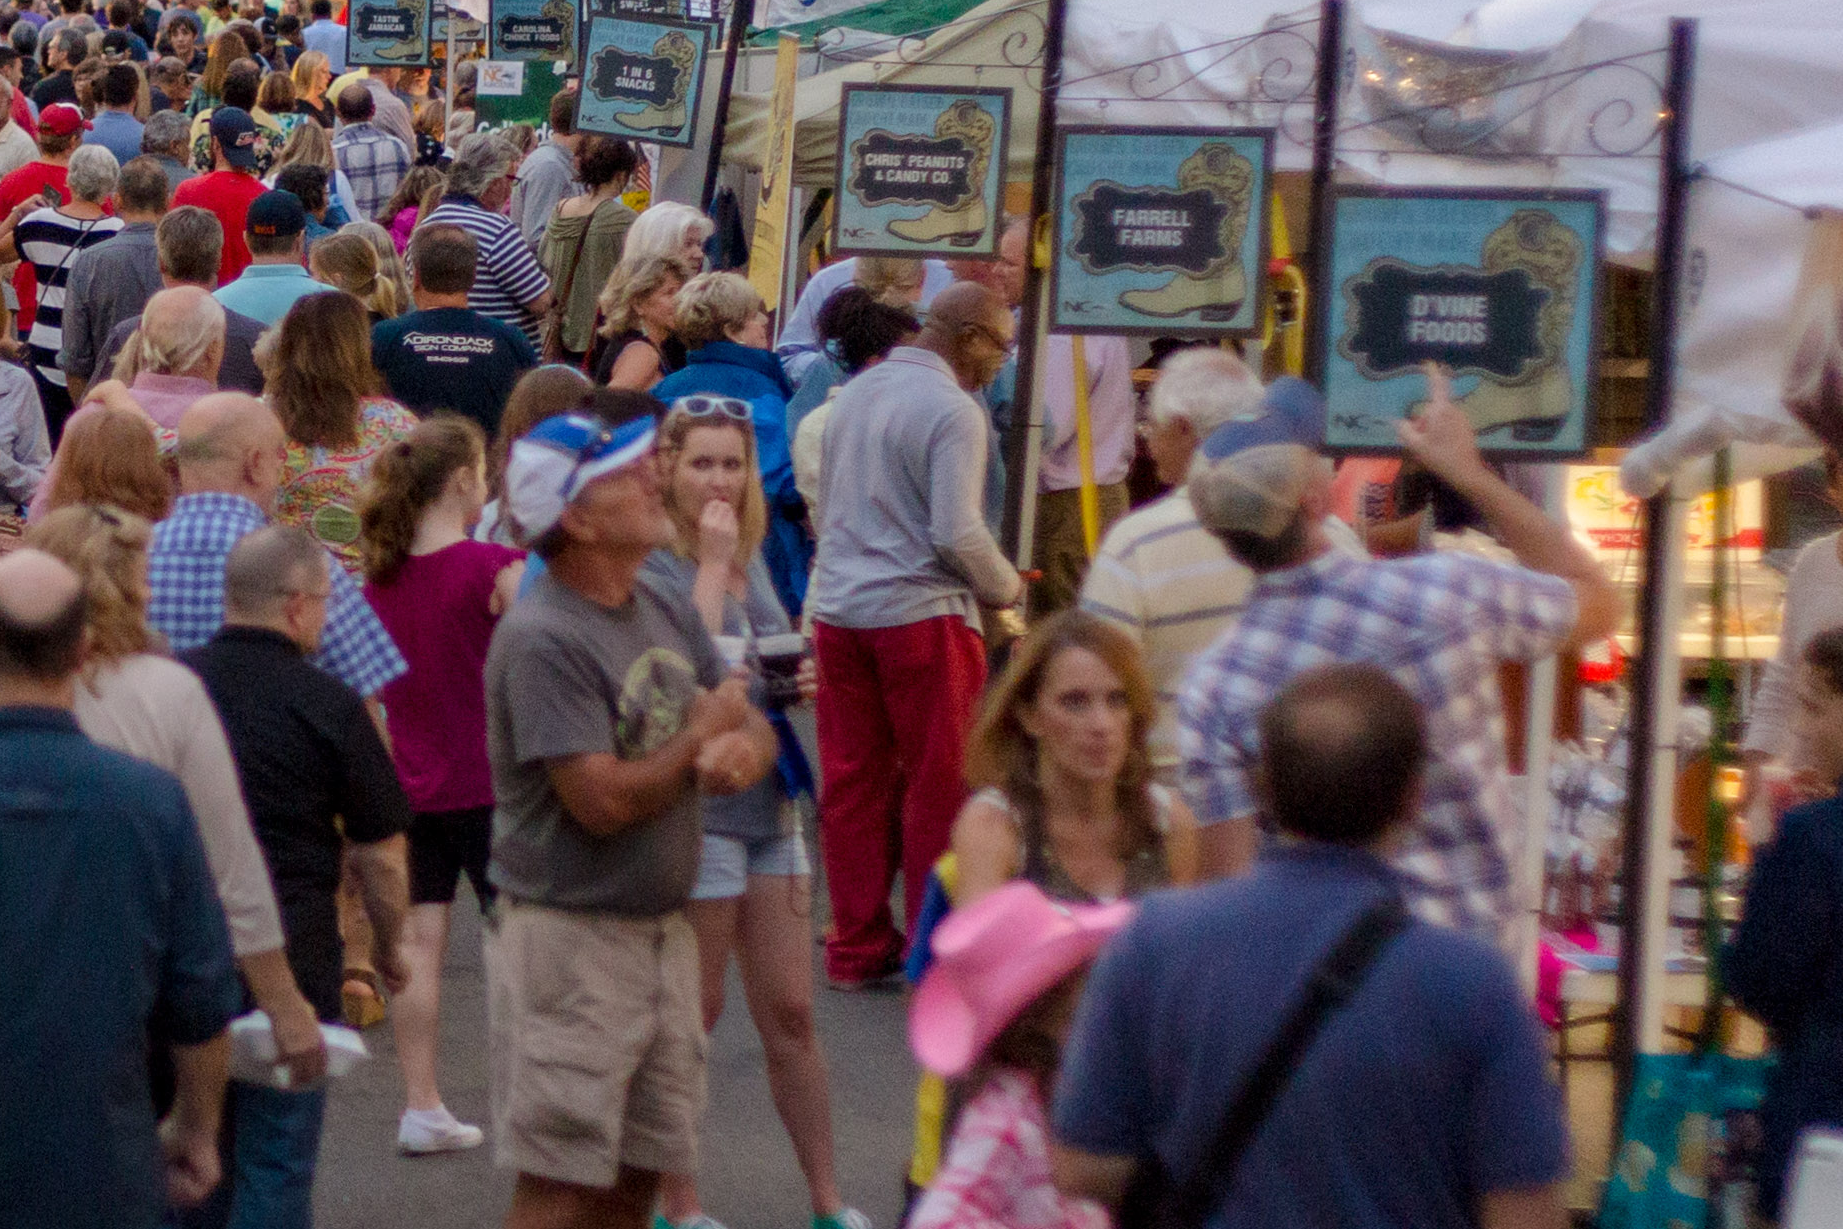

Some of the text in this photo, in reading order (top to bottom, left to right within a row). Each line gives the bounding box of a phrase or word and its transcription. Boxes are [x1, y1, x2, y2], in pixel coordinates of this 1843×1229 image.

[368, 23, 405, 32] JAMAICAN
[512, 25, 552, 34] CAROLINA
[631, 66, 643, 78] IN
[615, 76, 656, 91] SNACKS
[865, 153, 965, 169] CHRIS' PEANUTS
[874, 169, 953, 184] & CANDY CO.
[1113, 209, 1191, 227] FARRELL
[1119, 229, 1182, 247] FARMS
[1411, 294, 1488, 318] D'VINE
[403, 331, 494, 347] ADIRONDACK
[1410, 320, 1487, 344] FOODS
[414, 344, 493, 354] SIGN COMPANY
